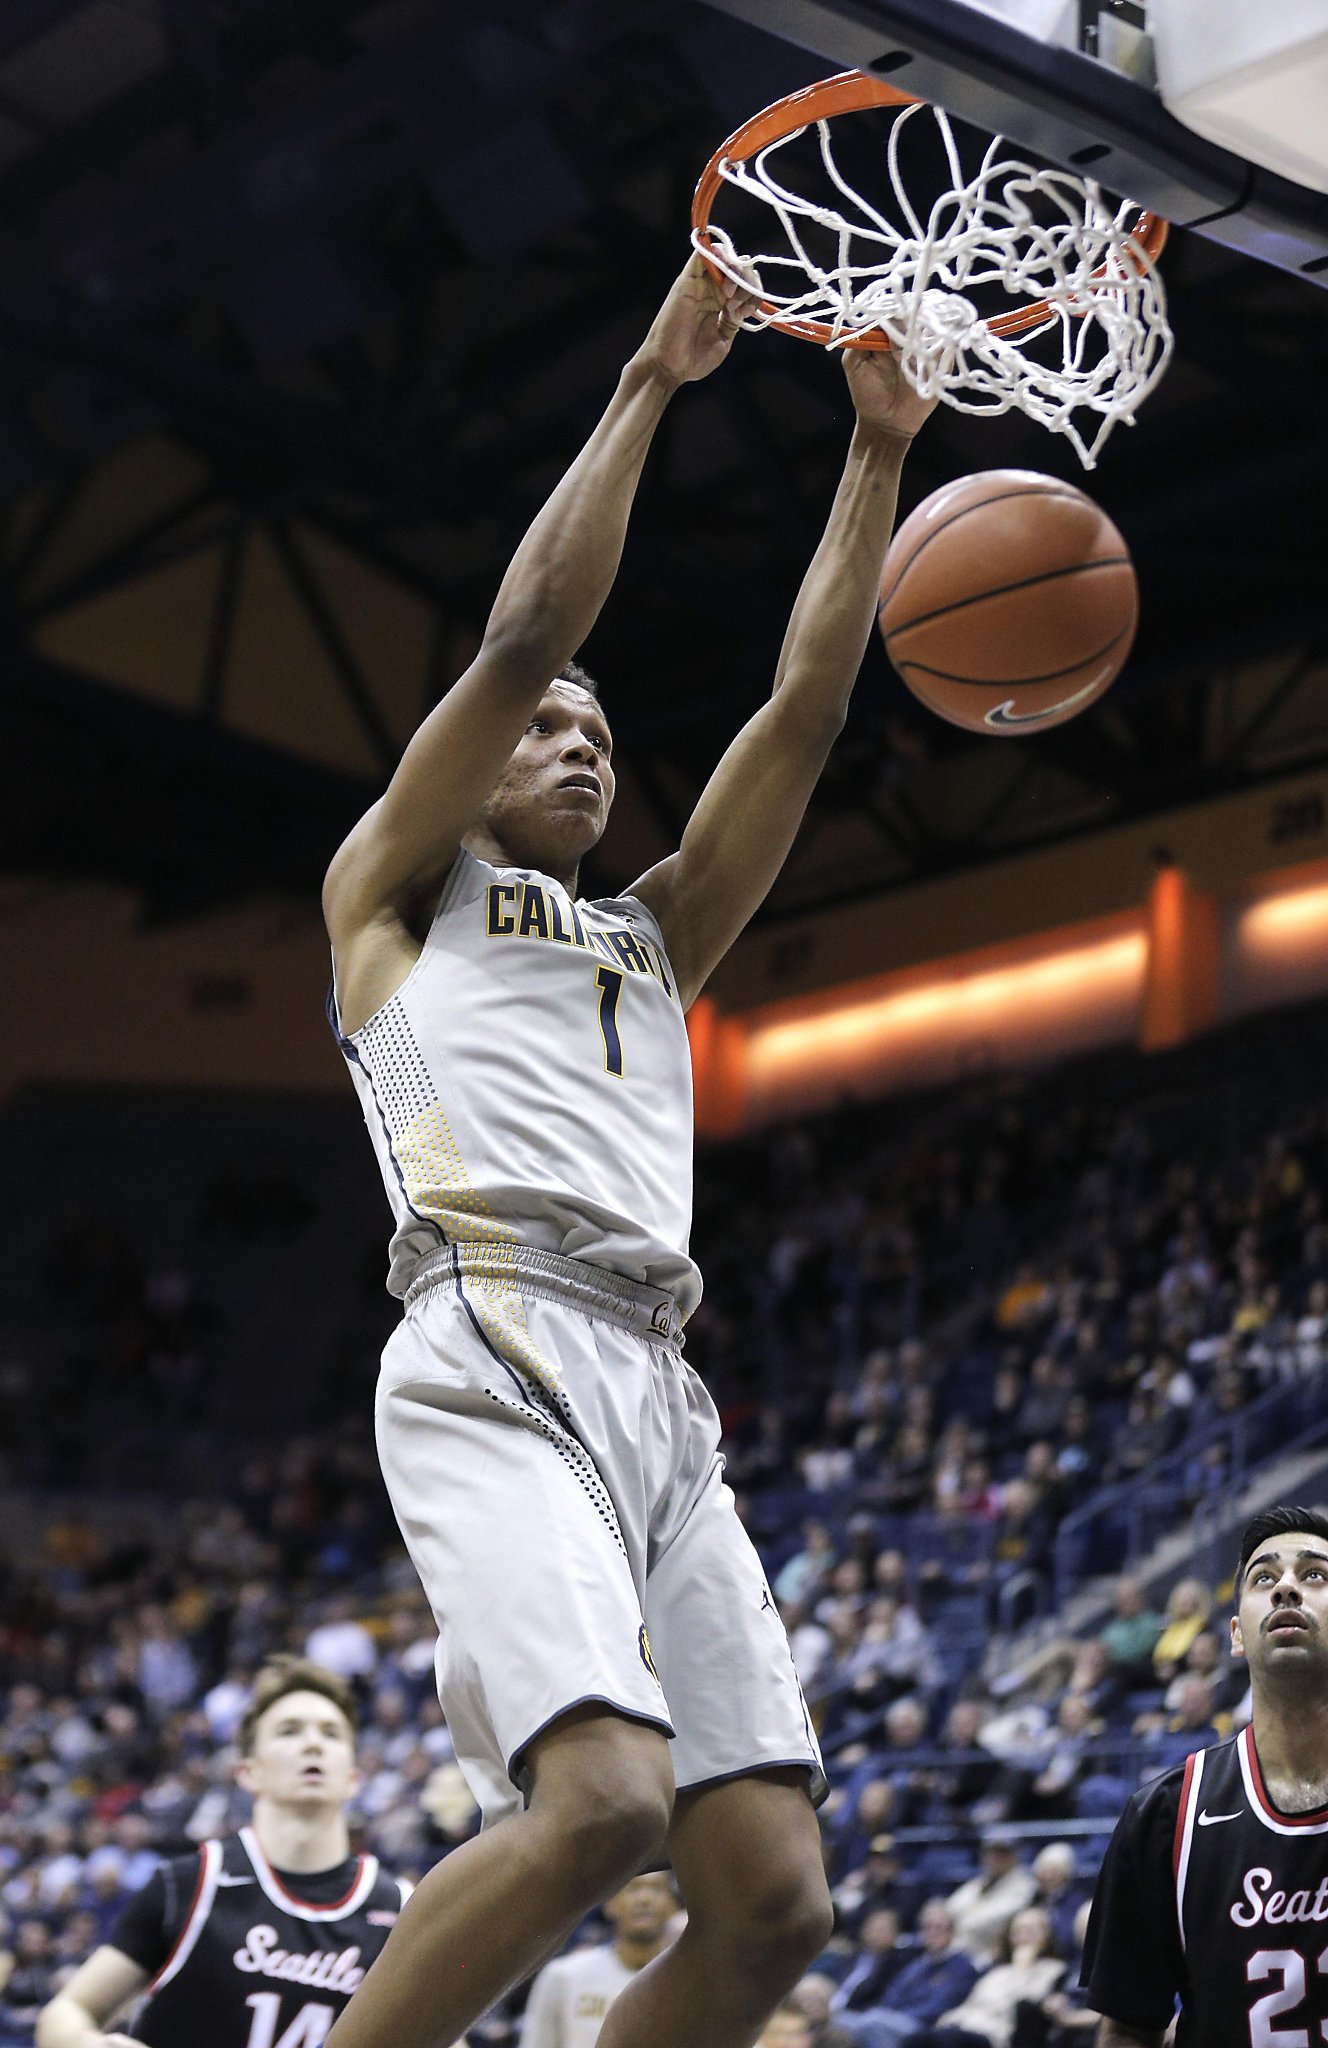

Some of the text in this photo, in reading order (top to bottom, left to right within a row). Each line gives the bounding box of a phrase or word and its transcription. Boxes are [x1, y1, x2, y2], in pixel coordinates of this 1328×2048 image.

[594, 964, 625, 1079] 1
[233, 1923, 366, 1995] Seattle
[1246, 1948, 1328, 2048] 2
